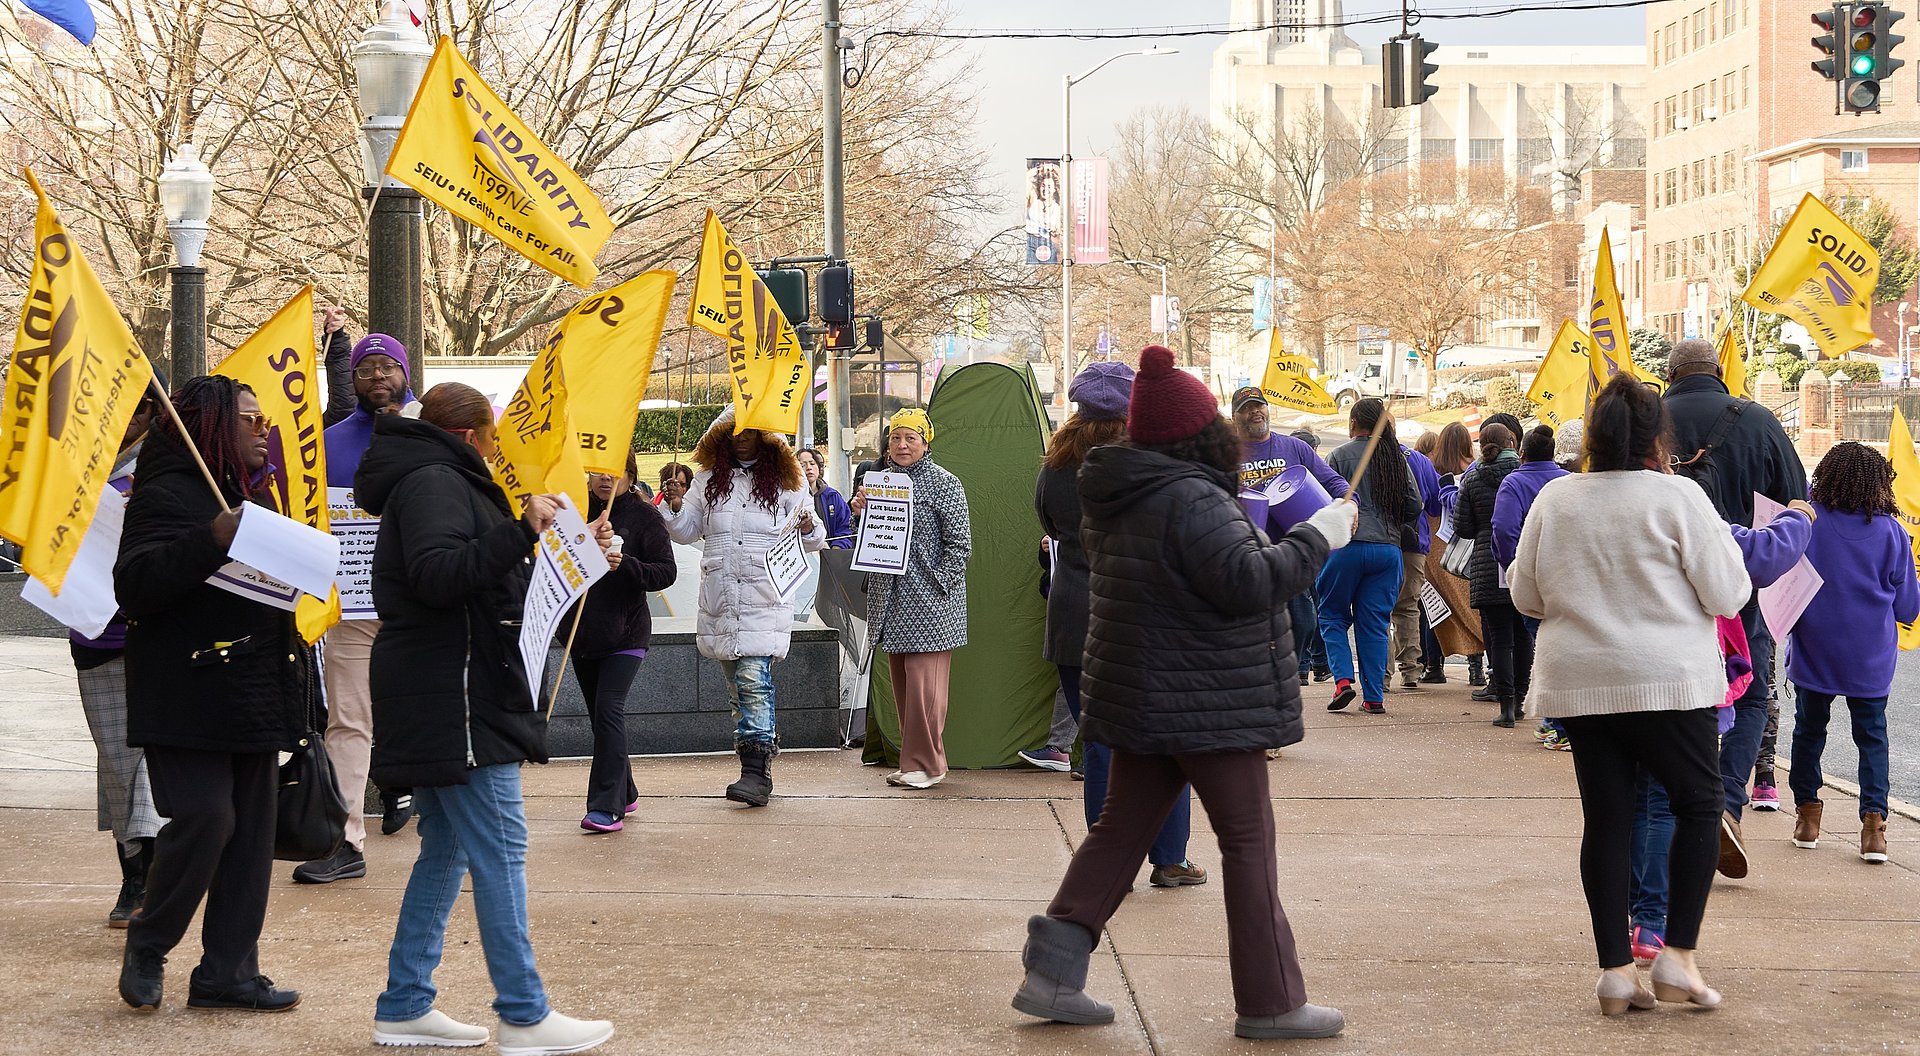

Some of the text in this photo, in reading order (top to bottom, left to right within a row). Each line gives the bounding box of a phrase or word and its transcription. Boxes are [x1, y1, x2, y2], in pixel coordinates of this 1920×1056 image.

[452, 77, 591, 230] SOLIDARITY
[472, 164, 538, 217] 1199NE
[456, 187, 495, 221] Health
[497, 216, 523, 240] Care
[527, 233, 549, 252] For
[1283, 396, 1306, 406] Health
[500, 465, 521, 492] For
[865, 488, 910, 499] FOR FREE
[867, 543, 899, 551] STRUGGLING
[556, 550, 585, 592] FREE
